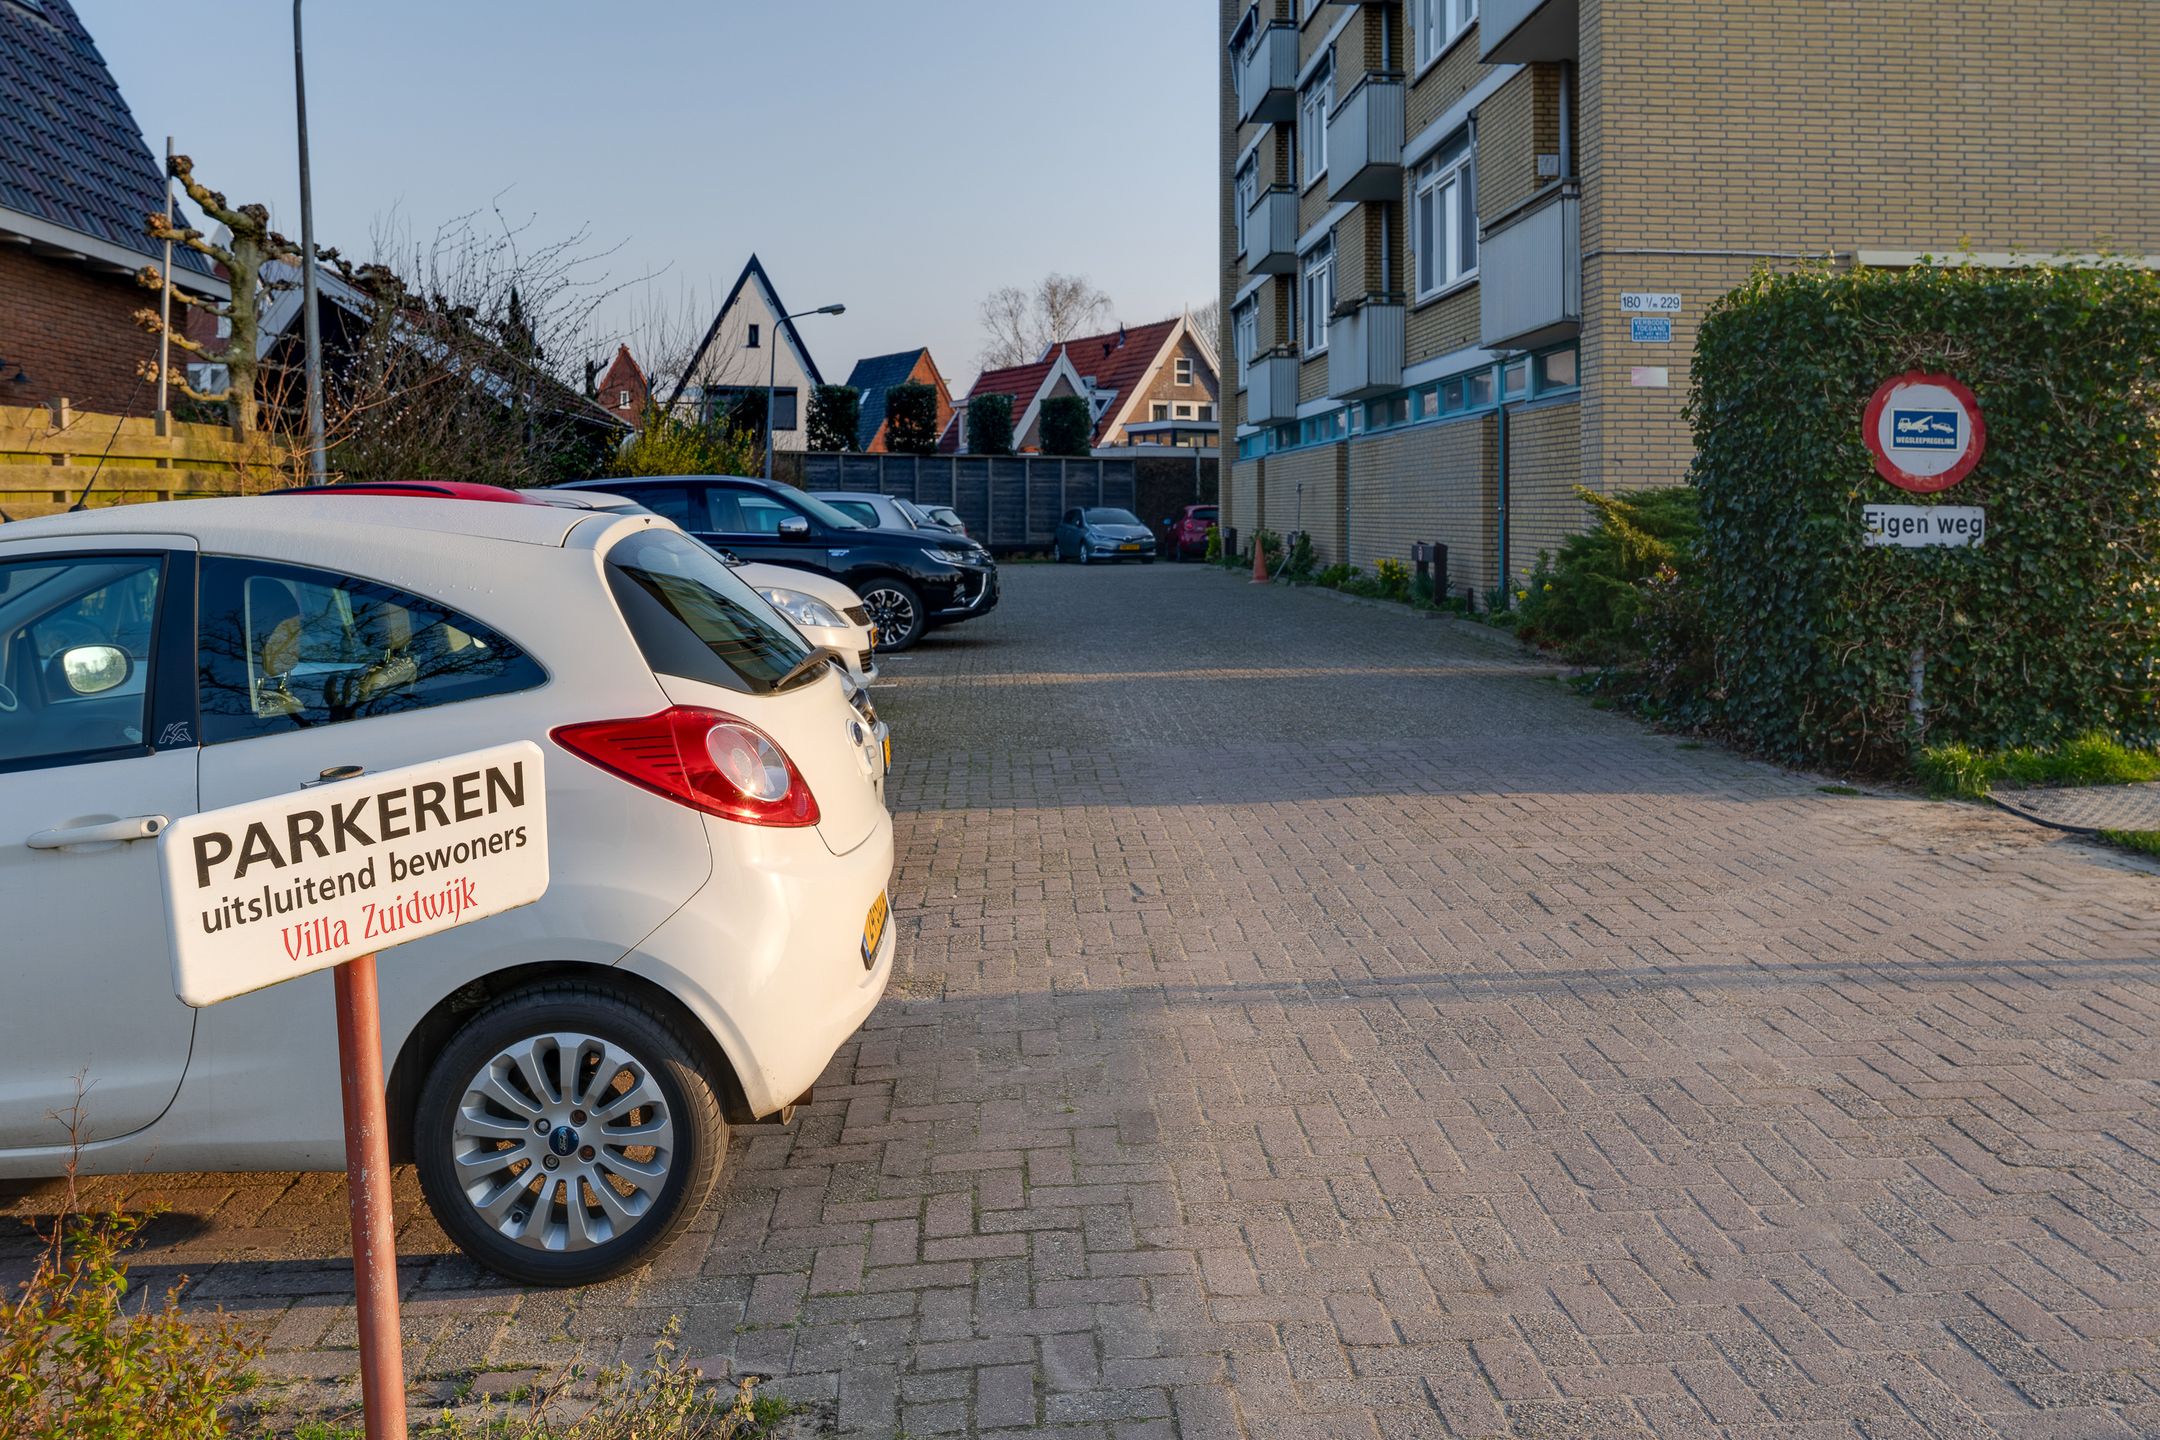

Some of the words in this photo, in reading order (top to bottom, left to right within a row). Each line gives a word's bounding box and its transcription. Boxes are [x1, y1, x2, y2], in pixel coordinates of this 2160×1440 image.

[1623, 296, 1641, 308] 180
[1660, 296, 1680, 309] 229
[1896, 436, 1955, 445] WEGSLEEPREGELING
[1866, 512, 1929, 538] Eigen
[1937, 517, 1983, 539] weg
[193, 761, 525, 889] PARKEREN
[202, 857, 376, 934] uitsluitend
[390, 825, 528, 883] bewoners
[281, 915, 350, 961] Villa
[361, 877, 478, 939] Zuidwijk
